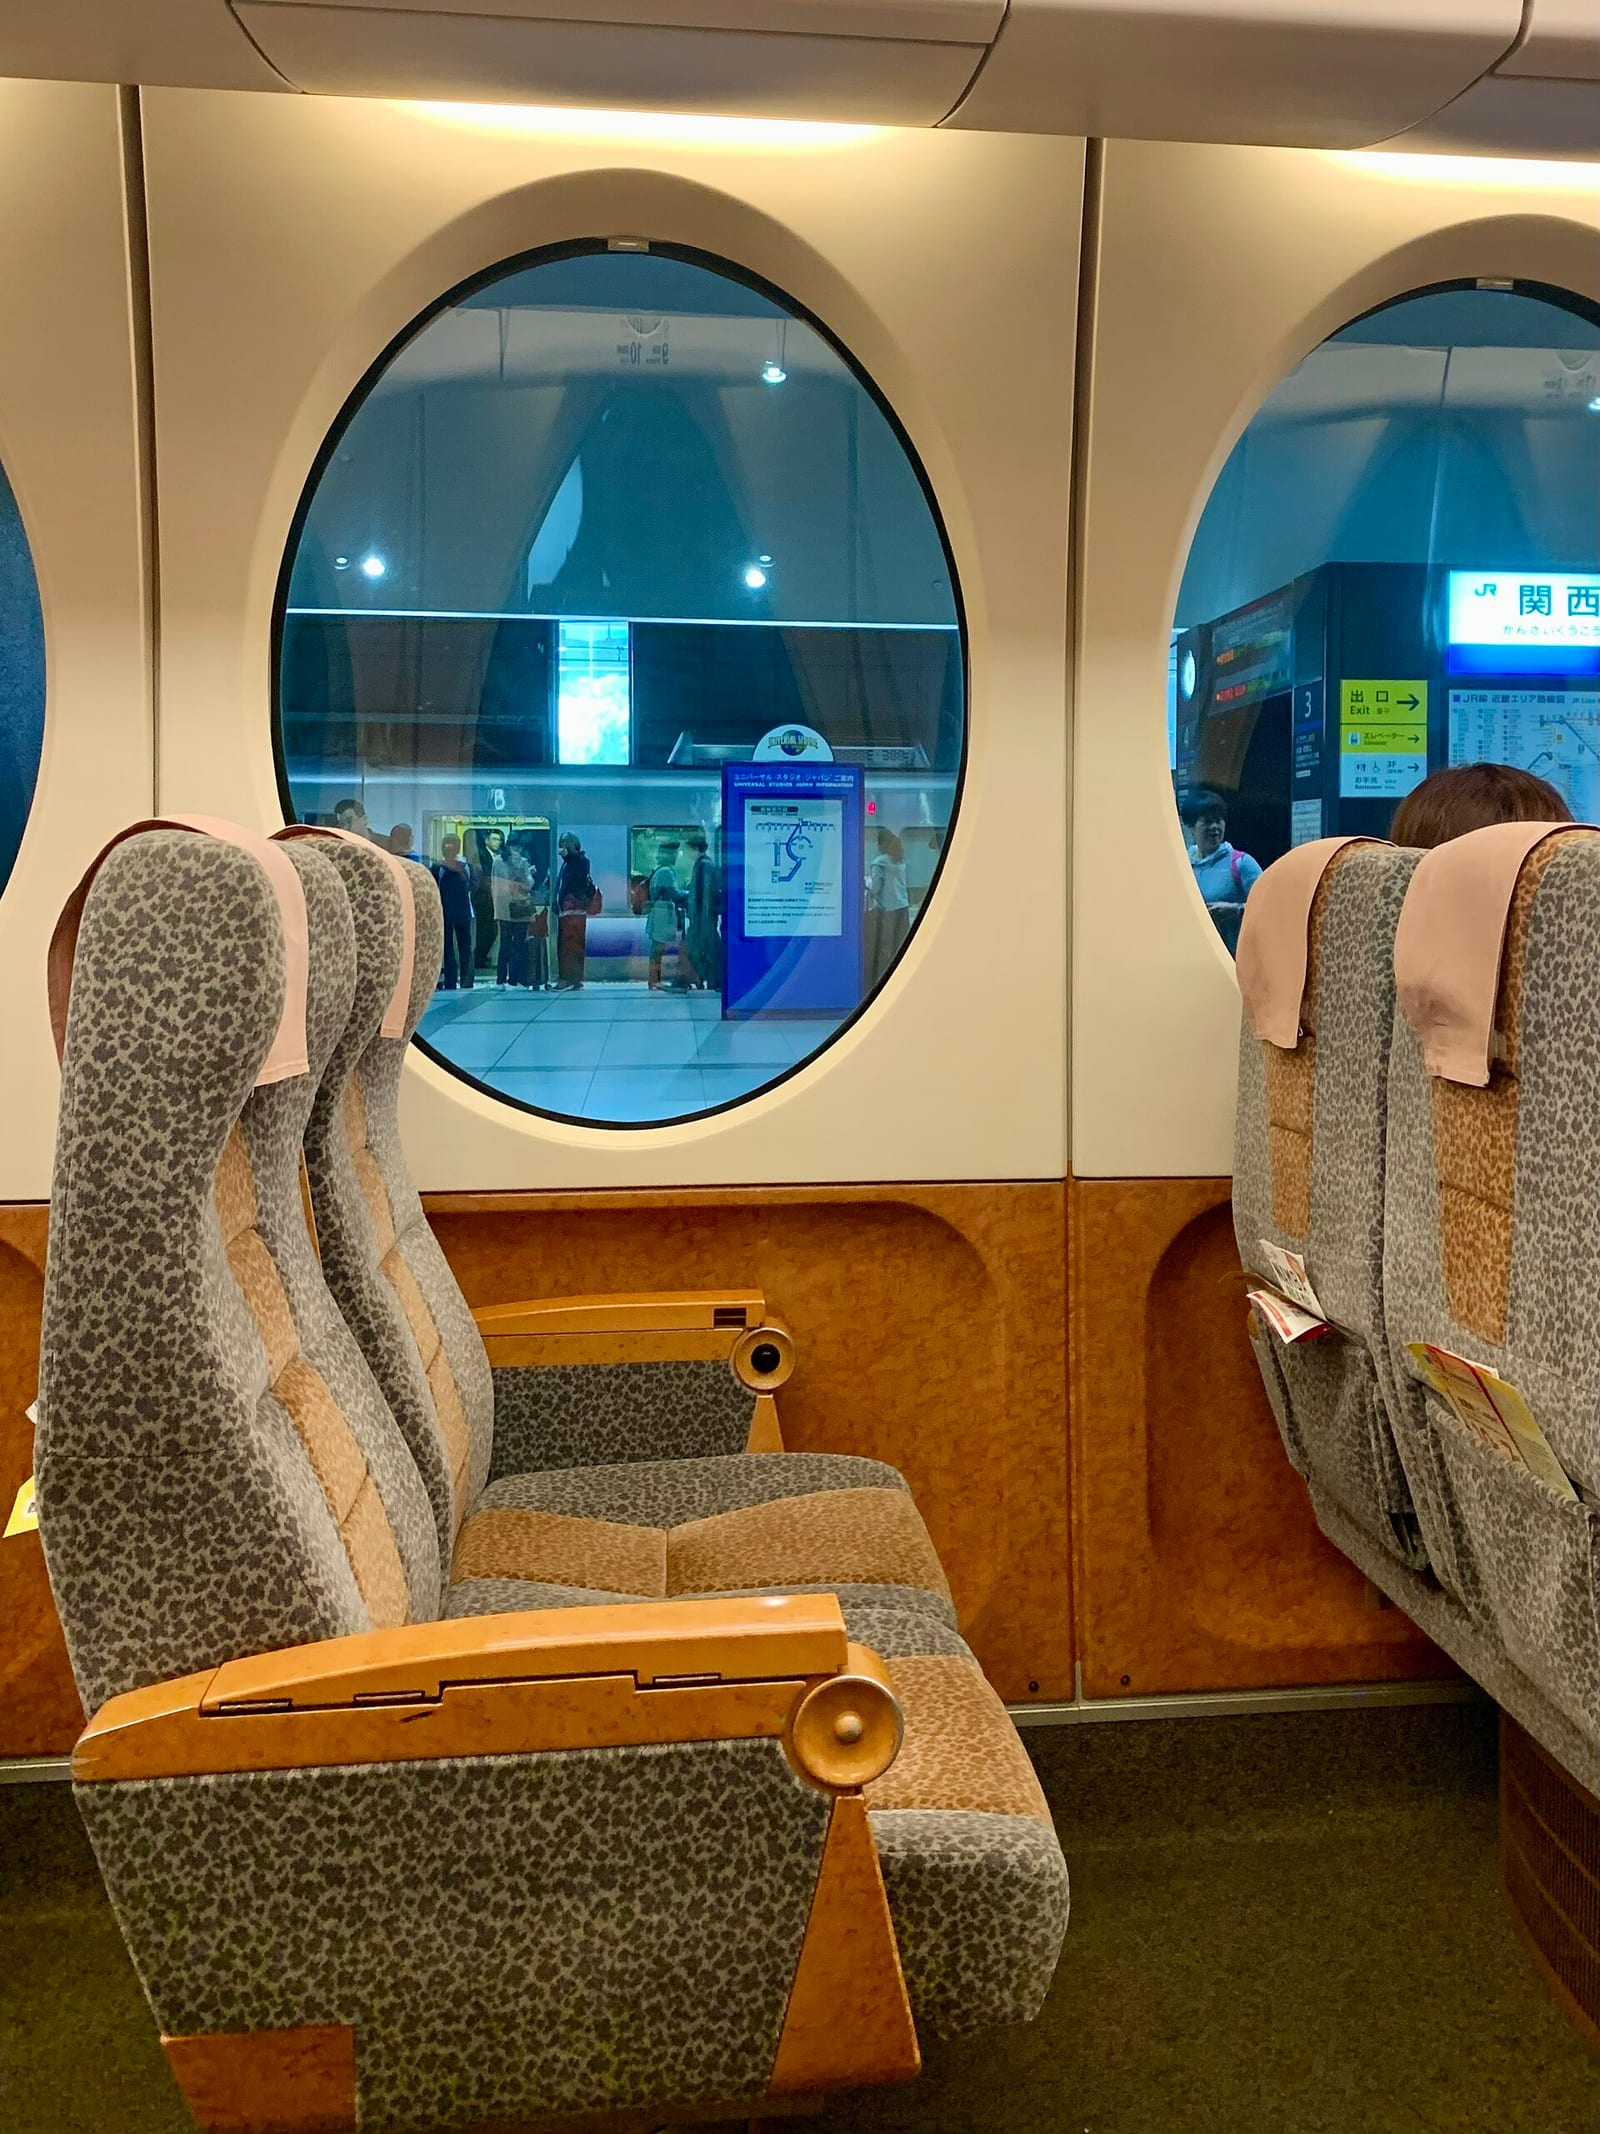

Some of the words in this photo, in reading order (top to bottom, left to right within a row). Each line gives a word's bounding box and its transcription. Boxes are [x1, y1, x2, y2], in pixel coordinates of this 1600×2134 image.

[1475, 583, 1497, 596] JR
[1519, 584, 1600, 617] 関西
[1350, 690, 1389, 703] 出口
[1305, 691, 1312, 718] 3
[1350, 705, 1370, 715] Exit
